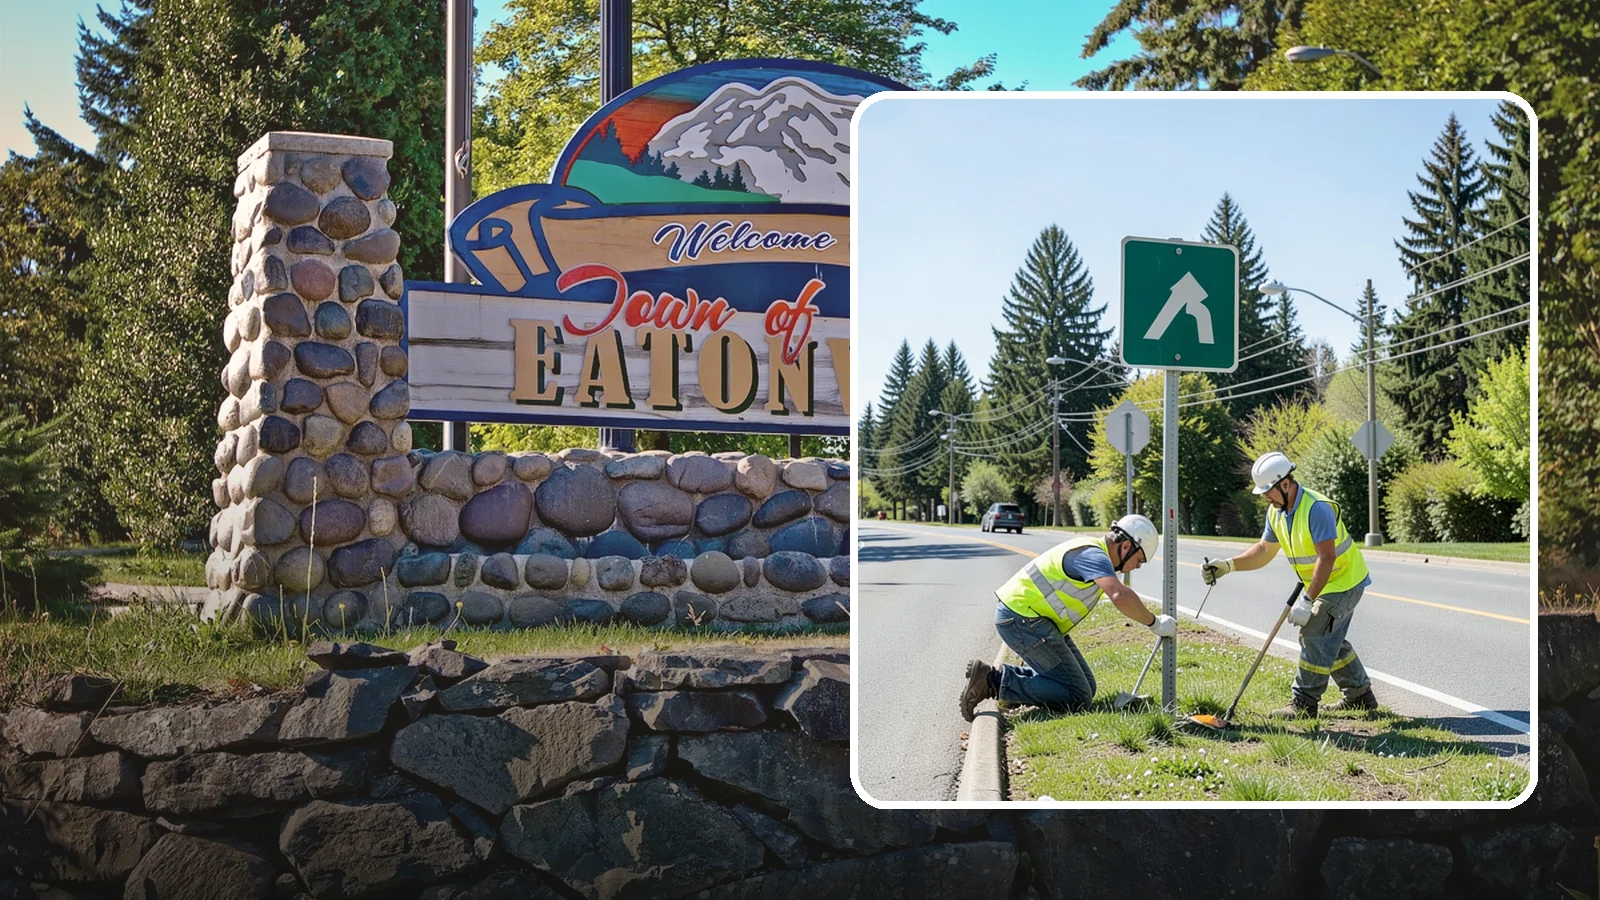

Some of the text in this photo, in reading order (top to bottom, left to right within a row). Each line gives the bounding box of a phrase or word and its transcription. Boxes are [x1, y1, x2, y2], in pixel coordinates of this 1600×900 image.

[653, 221, 836, 262] Welcome
[556, 264, 826, 365] Town of
